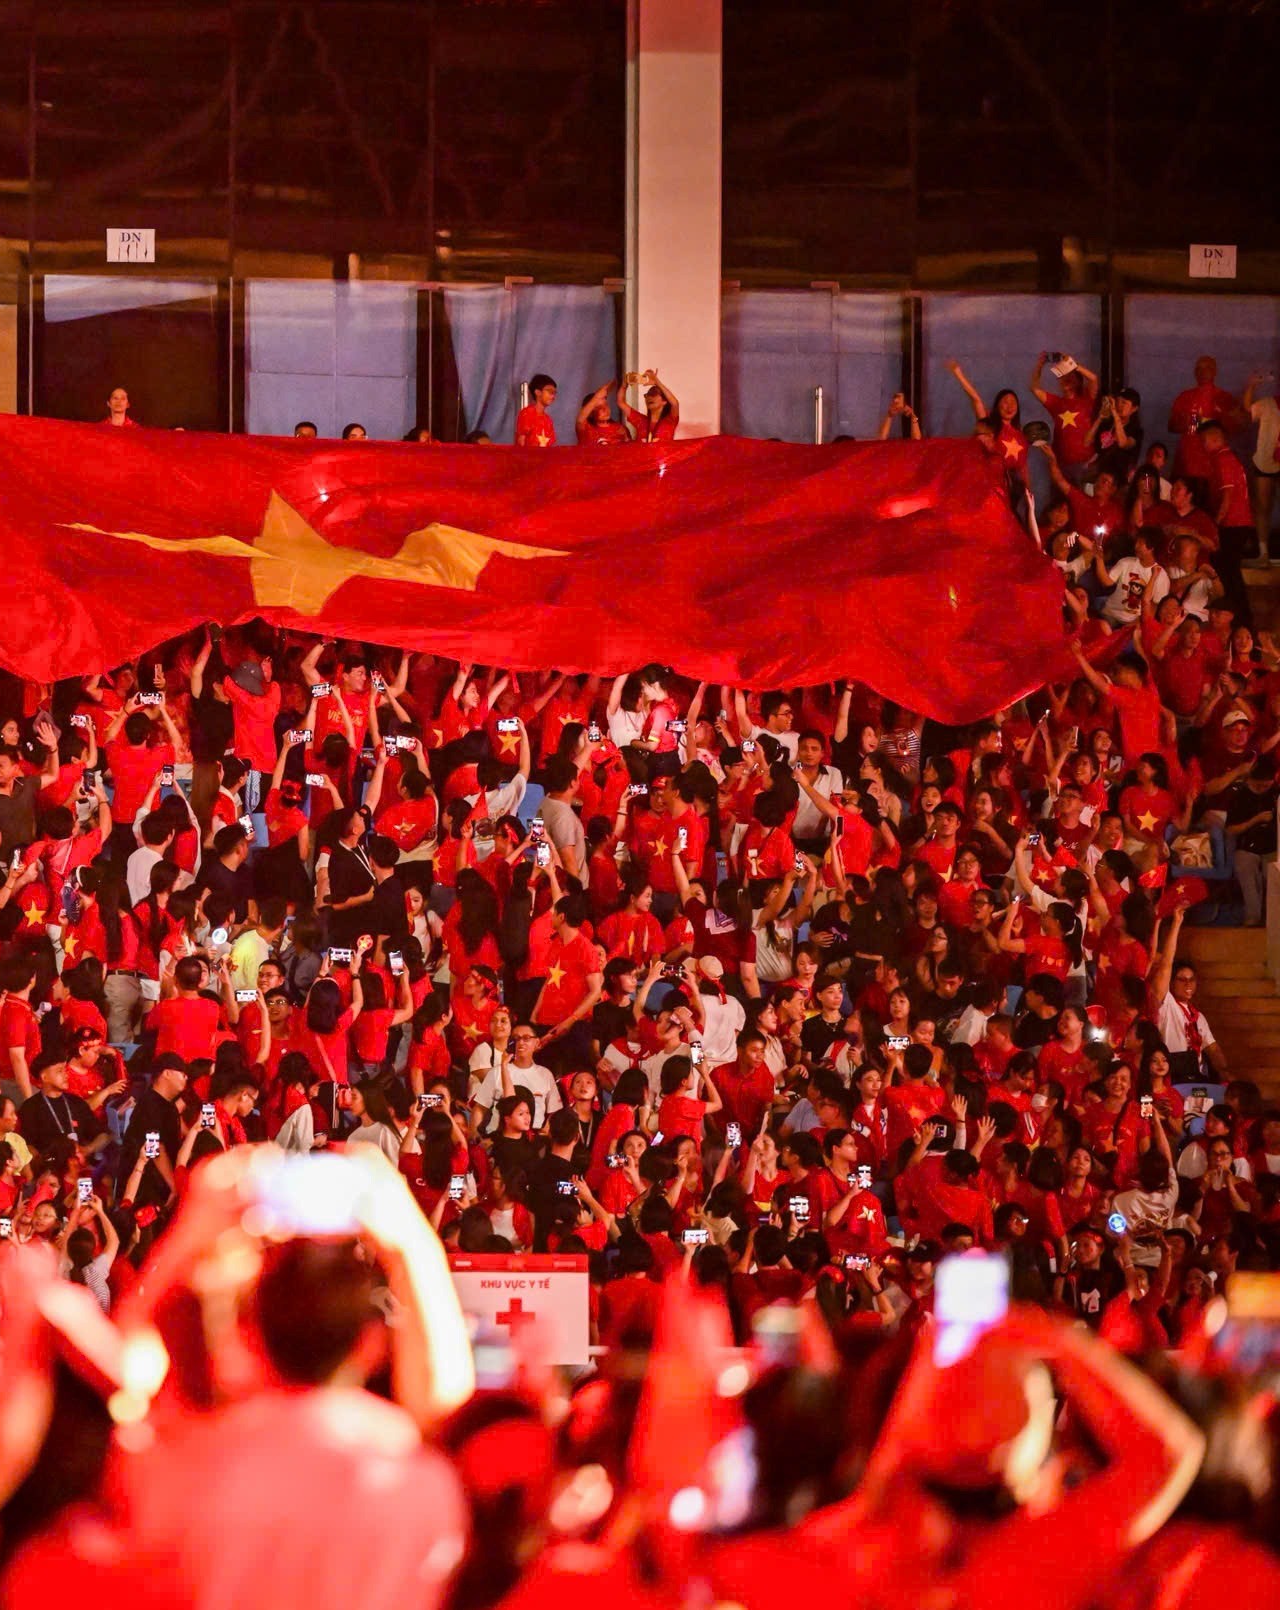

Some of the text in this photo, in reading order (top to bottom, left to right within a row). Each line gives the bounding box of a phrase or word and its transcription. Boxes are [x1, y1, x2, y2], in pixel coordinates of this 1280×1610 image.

[121, 232, 141, 242] DN
[480, 1280, 502, 1289] KHU
[529, 1280, 537, 1289] Y
[538, 1276, 551, 1289] TẾ
